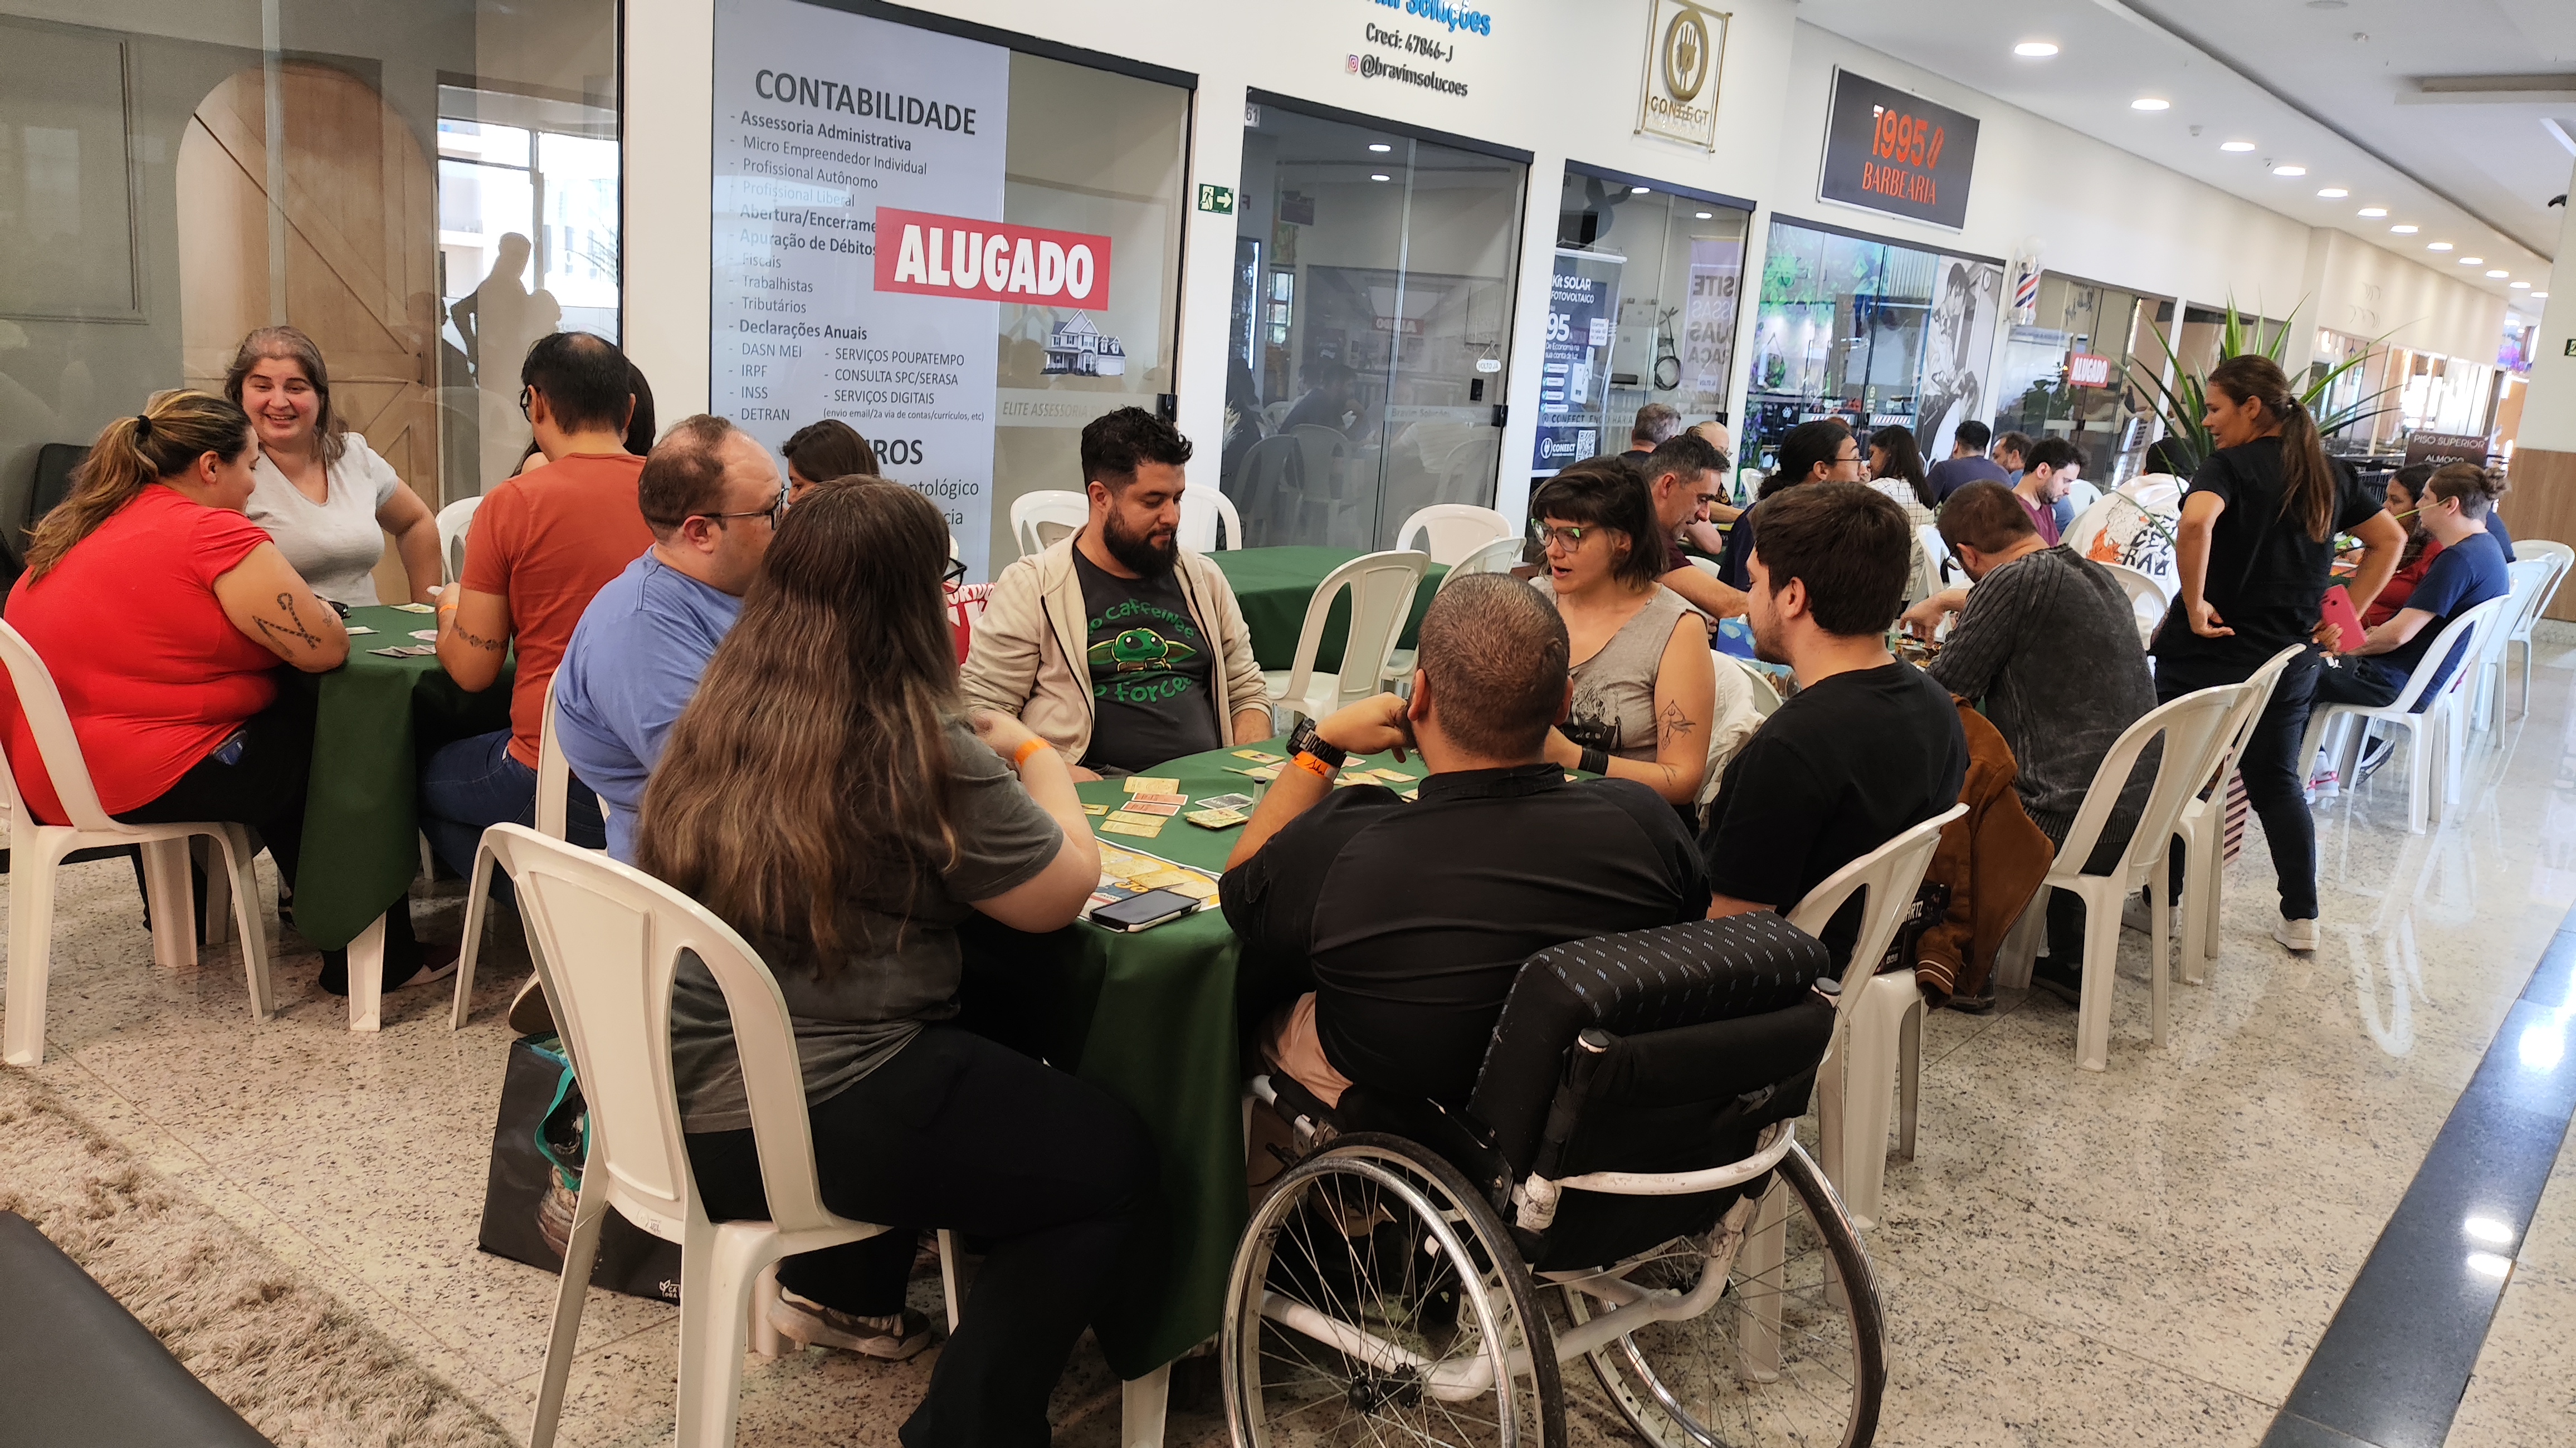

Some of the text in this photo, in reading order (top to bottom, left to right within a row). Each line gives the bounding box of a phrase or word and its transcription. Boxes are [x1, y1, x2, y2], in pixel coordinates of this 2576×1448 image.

[1367, 22, 1453, 63] Creci: 47846-J
[1360, 54, 1468, 96] @bravimsolucoes
[755, 69, 976, 135] CONTABILIDADE
[1246, 107, 1258, 123] 61
[741, 110, 911, 151] Assessoria Administrativa
[1872, 104, 1929, 167] 1995
[744, 135, 927, 175] Micro Empreendedor Individual
[743, 158, 878, 189] Profissional Autônomo
[1862, 162, 1936, 206] BARBEARIA
[743, 180, 855, 207] Profissional Liberal
[740, 228, 806, 250] Apuração
[809, 236, 826, 250] de
[743, 253, 782, 268] Fiscais
[894, 223, 1095, 300] ALUGADO
[742, 275, 813, 293] Trabalhistas
[1564, 275, 1592, 291] SOLAR
[741, 296, 807, 314] Tributários
[1551, 290, 1595, 304] FOTOVOLTAICO
[740, 319, 867, 341] Declarações Anuais
[742, 343, 802, 358] DASN MEI
[835, 348, 965, 366] SERVIÇOS POUPATEMPO
[741, 364, 768, 378] IRPF
[835, 369, 958, 386] CONSULTA SPC/SERASA
[741, 386, 768, 399] INSS
[835, 390, 935, 405] SERVIÇOS DIGITAIS
[741, 408, 790, 421] DETRAN
[823, 408, 847, 419] (envio
[849, 409, 882, 419] email/2a
[897, 410, 906, 419] de
[908, 410, 970, 422] contas/currículos,
[971, 412, 985, 422] etc)
[1003, 401, 1030, 416] ELITE
[2413, 434, 2485, 449] PISO SUPERIOR
